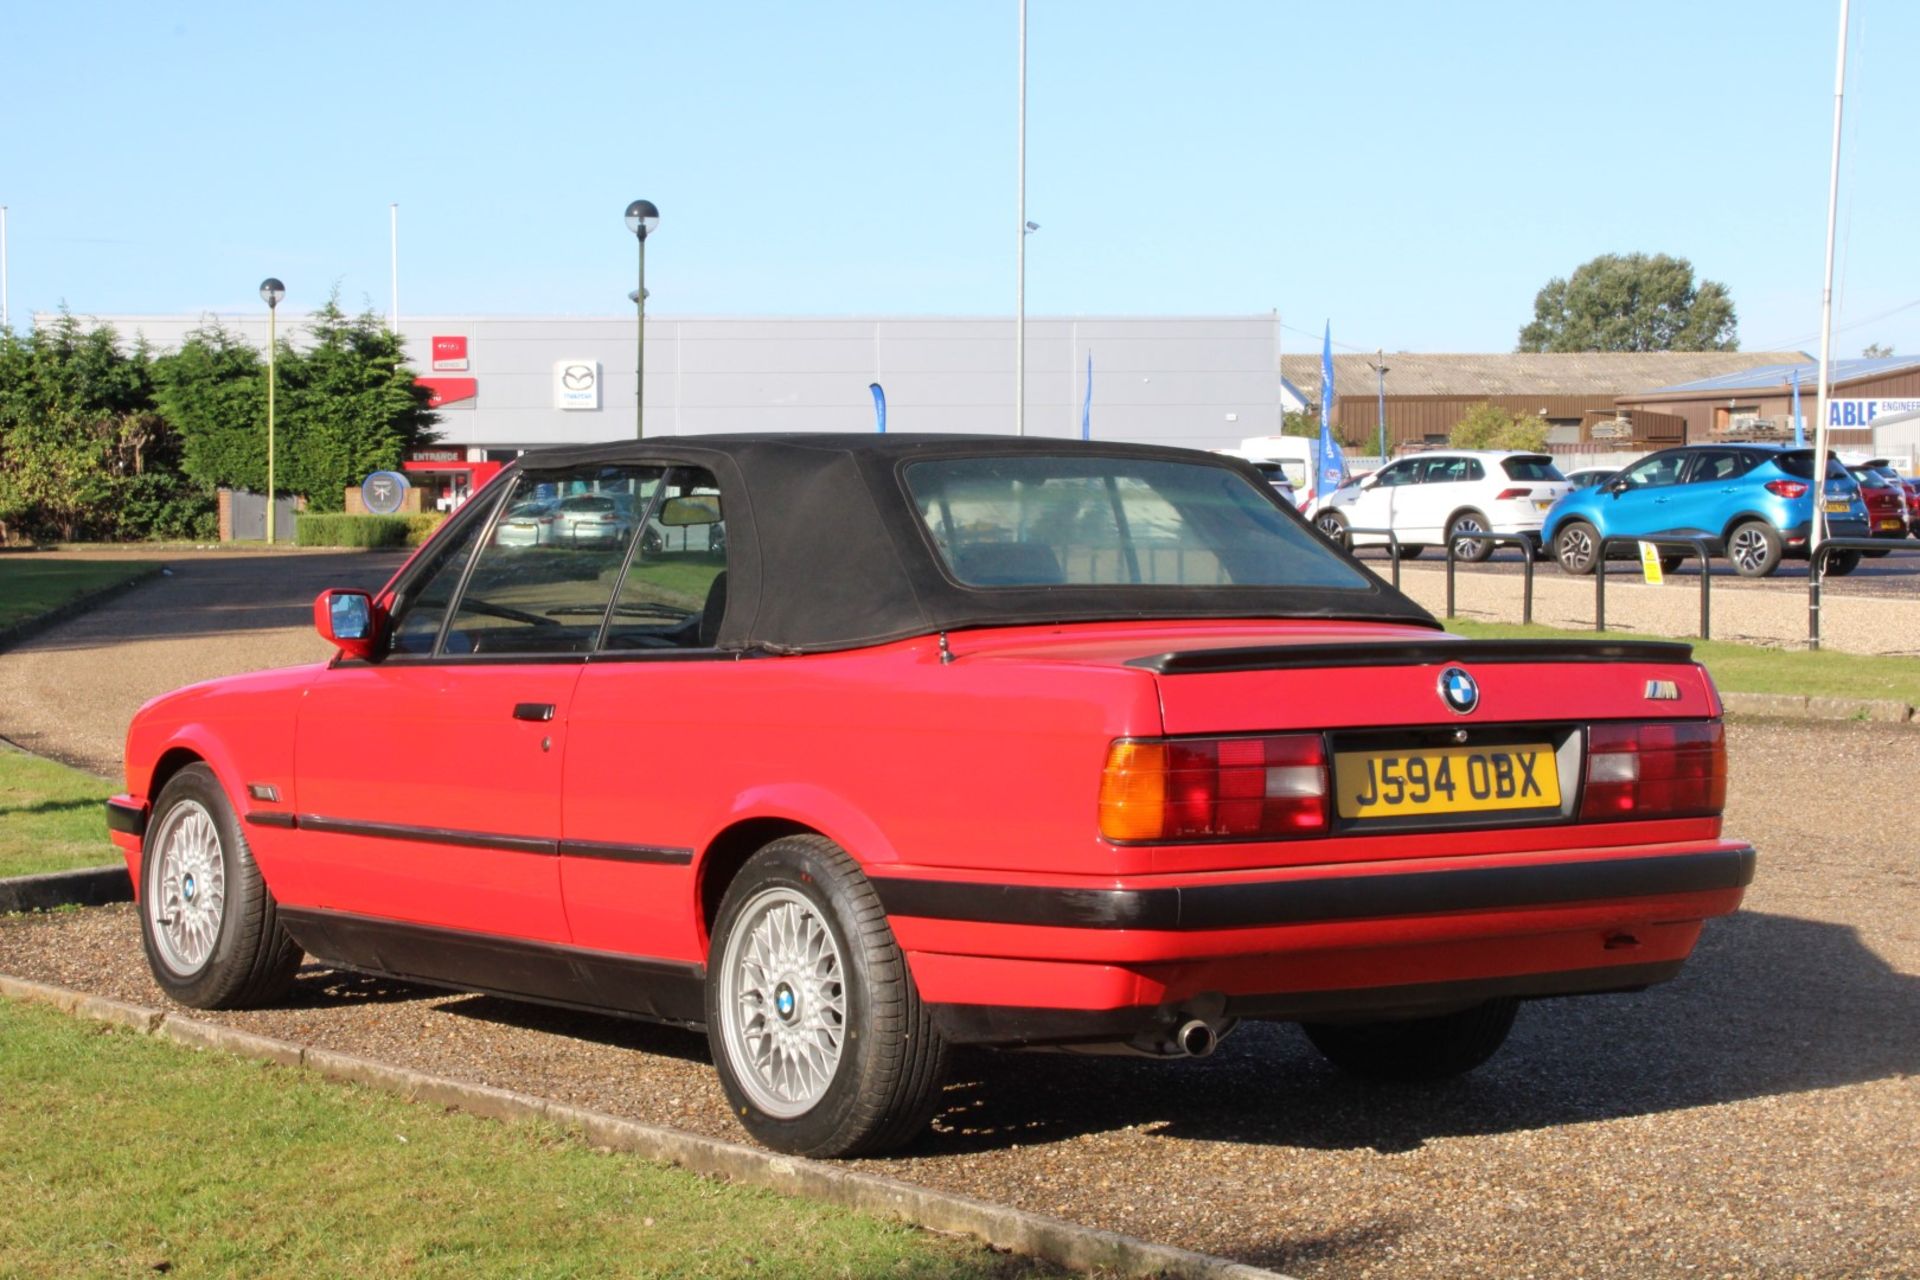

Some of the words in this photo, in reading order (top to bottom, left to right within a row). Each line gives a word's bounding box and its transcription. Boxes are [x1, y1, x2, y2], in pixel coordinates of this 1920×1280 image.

[413, 452, 458, 461] ENTRANCE
[1356, 756, 1456, 806] J594
[1466, 752, 1542, 800] OBX
